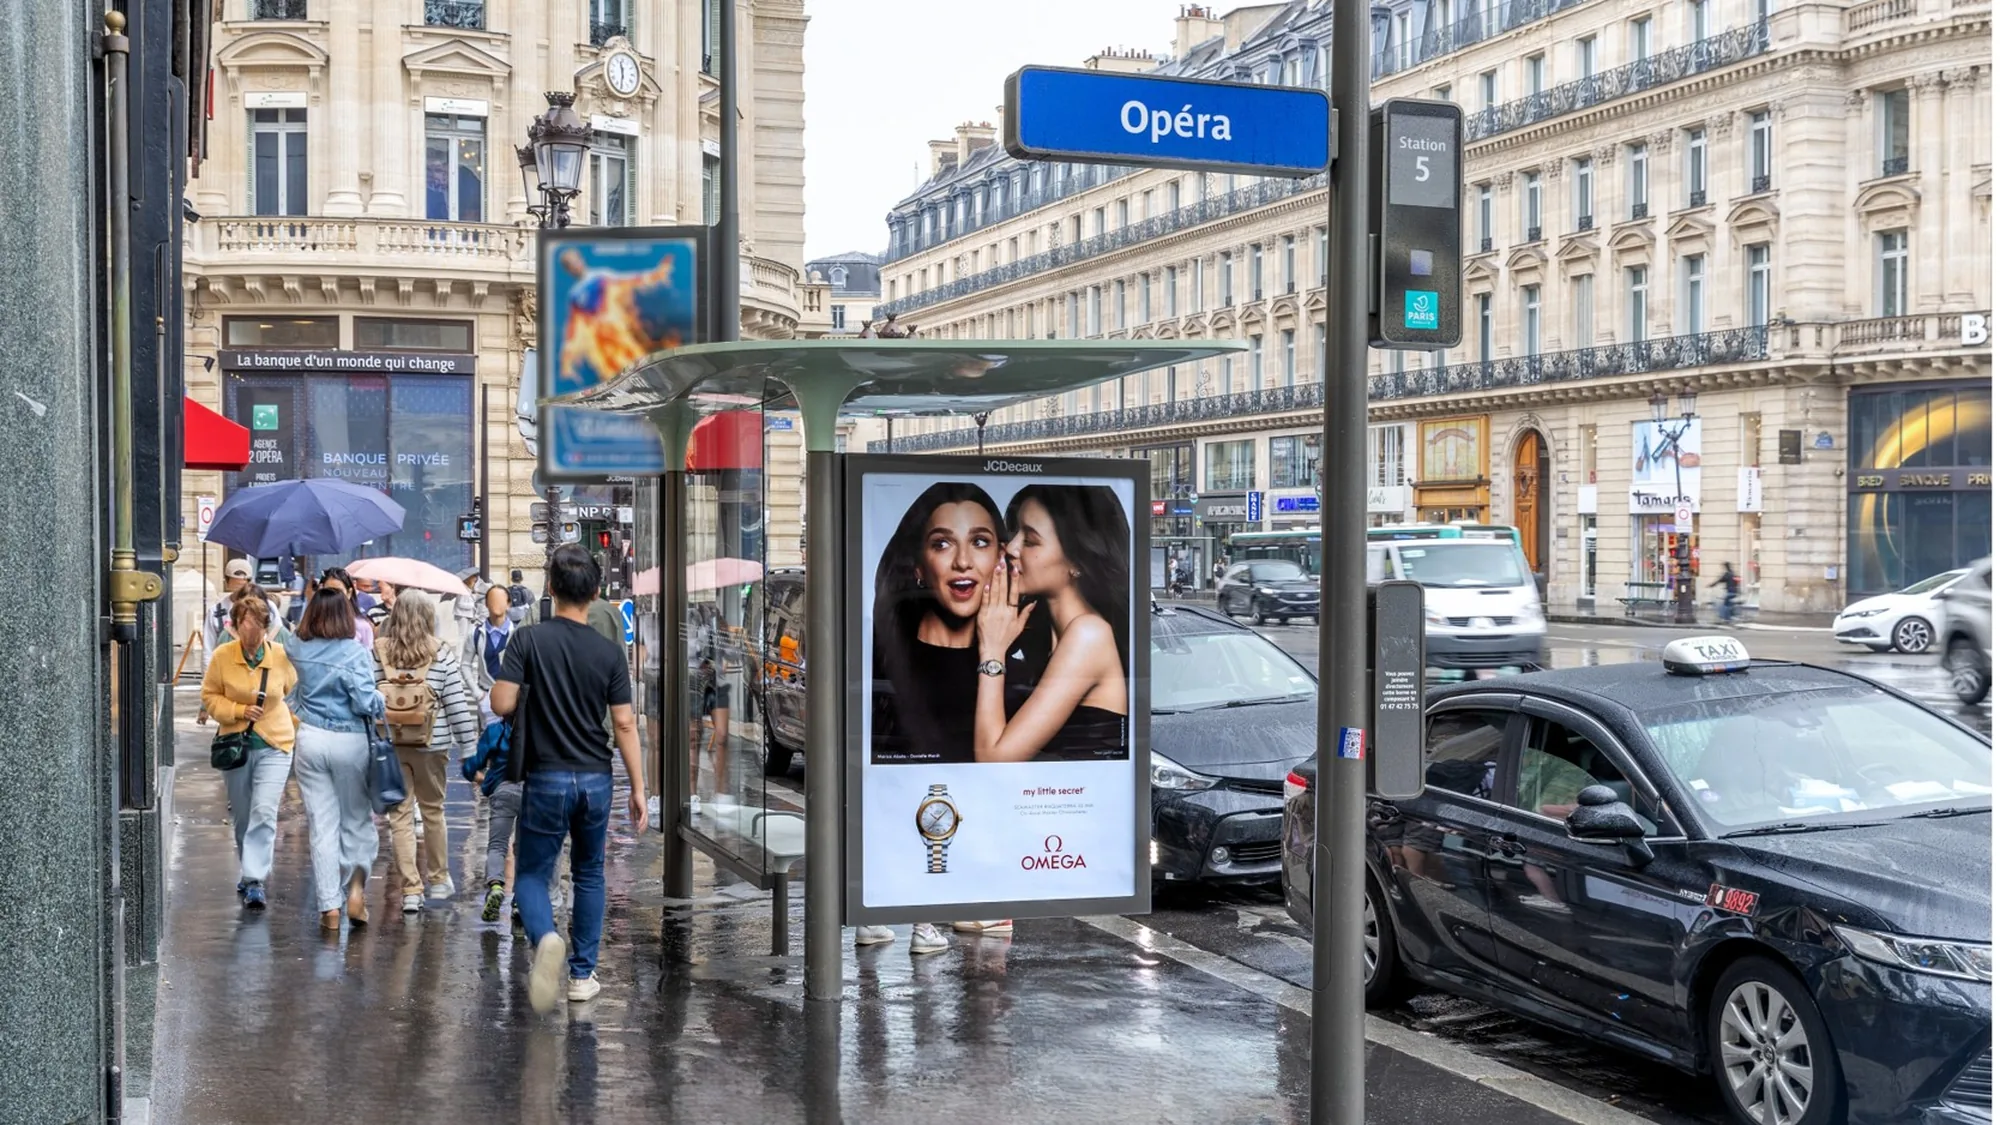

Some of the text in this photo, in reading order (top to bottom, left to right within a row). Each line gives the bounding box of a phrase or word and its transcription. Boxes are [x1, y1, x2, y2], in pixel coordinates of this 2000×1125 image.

[1120, 100, 1232, 143] Opéra
[1399, 136, 1446, 152] Station
[1415, 156, 1430, 182] 5
[1408, 311, 1435, 321] PARIS
[237, 354, 455, 372] La banque d'un monde qui change
[254, 439, 278, 449] AGENCE
[323, 452, 449, 465] BANQUE PRIVÉE
[323, 468, 387, 478] NOUVEAU
[983, 460, 1043, 473] JCDecaux
[1857, 476, 1884, 487] BRED
[1900, 475, 1950, 486] BANQUE
[1694, 643, 1739, 658] TAXI
[1023, 789, 1036, 797] my
[1037, 787, 1057, 796] little
[1021, 854, 1087, 870] OMEGA
[1723, 889, 1754, 913] 9892
